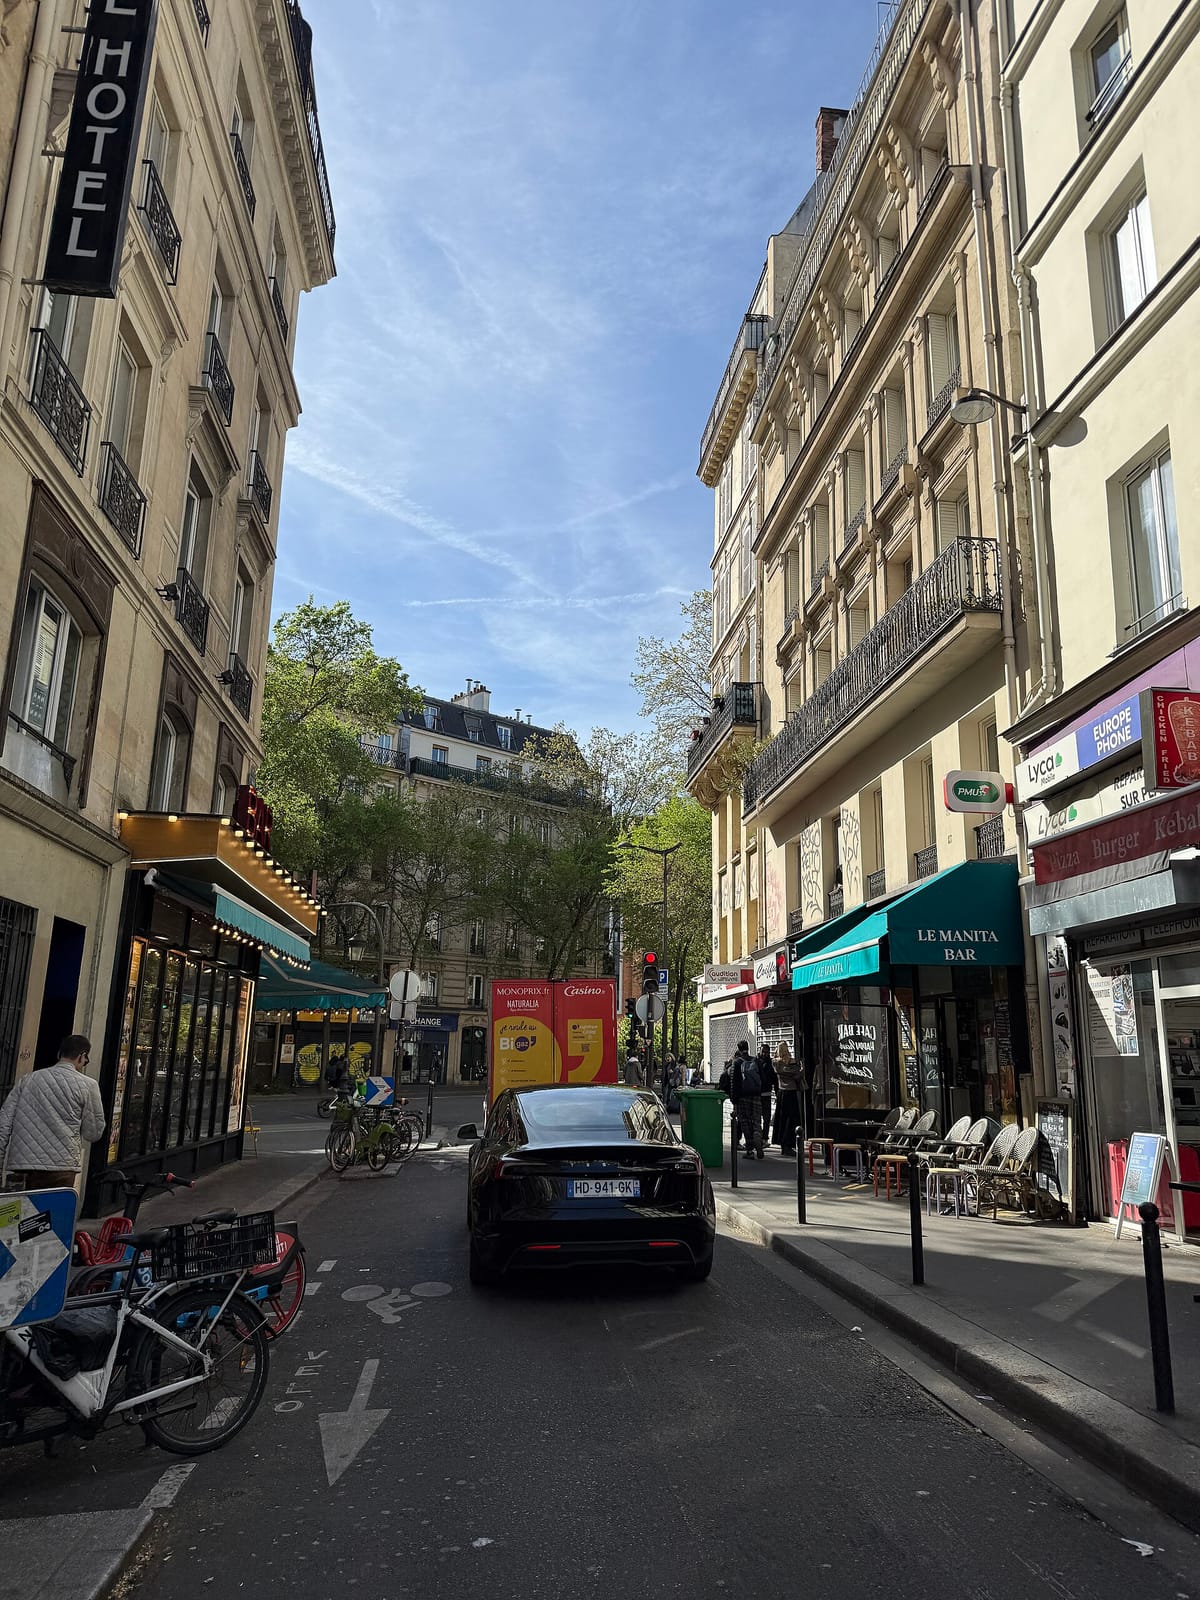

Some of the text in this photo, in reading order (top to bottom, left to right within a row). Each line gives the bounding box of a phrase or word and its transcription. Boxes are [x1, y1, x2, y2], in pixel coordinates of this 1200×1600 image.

[65, 37, 132, 259] HOTEL
[1093, 706, 1132, 741] EUROPE
[1183, 706, 1198, 761] KEBAB
[1096, 725, 1132, 757] PHONE
[1156, 695, 1170, 784] CHICKEN FRIED
[1028, 755, 1055, 784] Lyca
[1113, 766, 1144, 791] REPAR
[957, 787, 979, 796] PMU
[1120, 790, 1140, 809] SUR
[1038, 807, 1068, 837] Lyca
[1050, 850, 1081, 873] Pizza
[1091, 830, 1141, 860] Burger
[917, 929, 999, 942] LE MANITA
[944, 948, 978, 961] BAR
[711, 969, 738, 978] audition
[497, 987, 550, 996] MONOPRIX.fr
[507, 999, 539, 1009] NATURALIA
[409, 1017, 441, 1026] CHANGE
